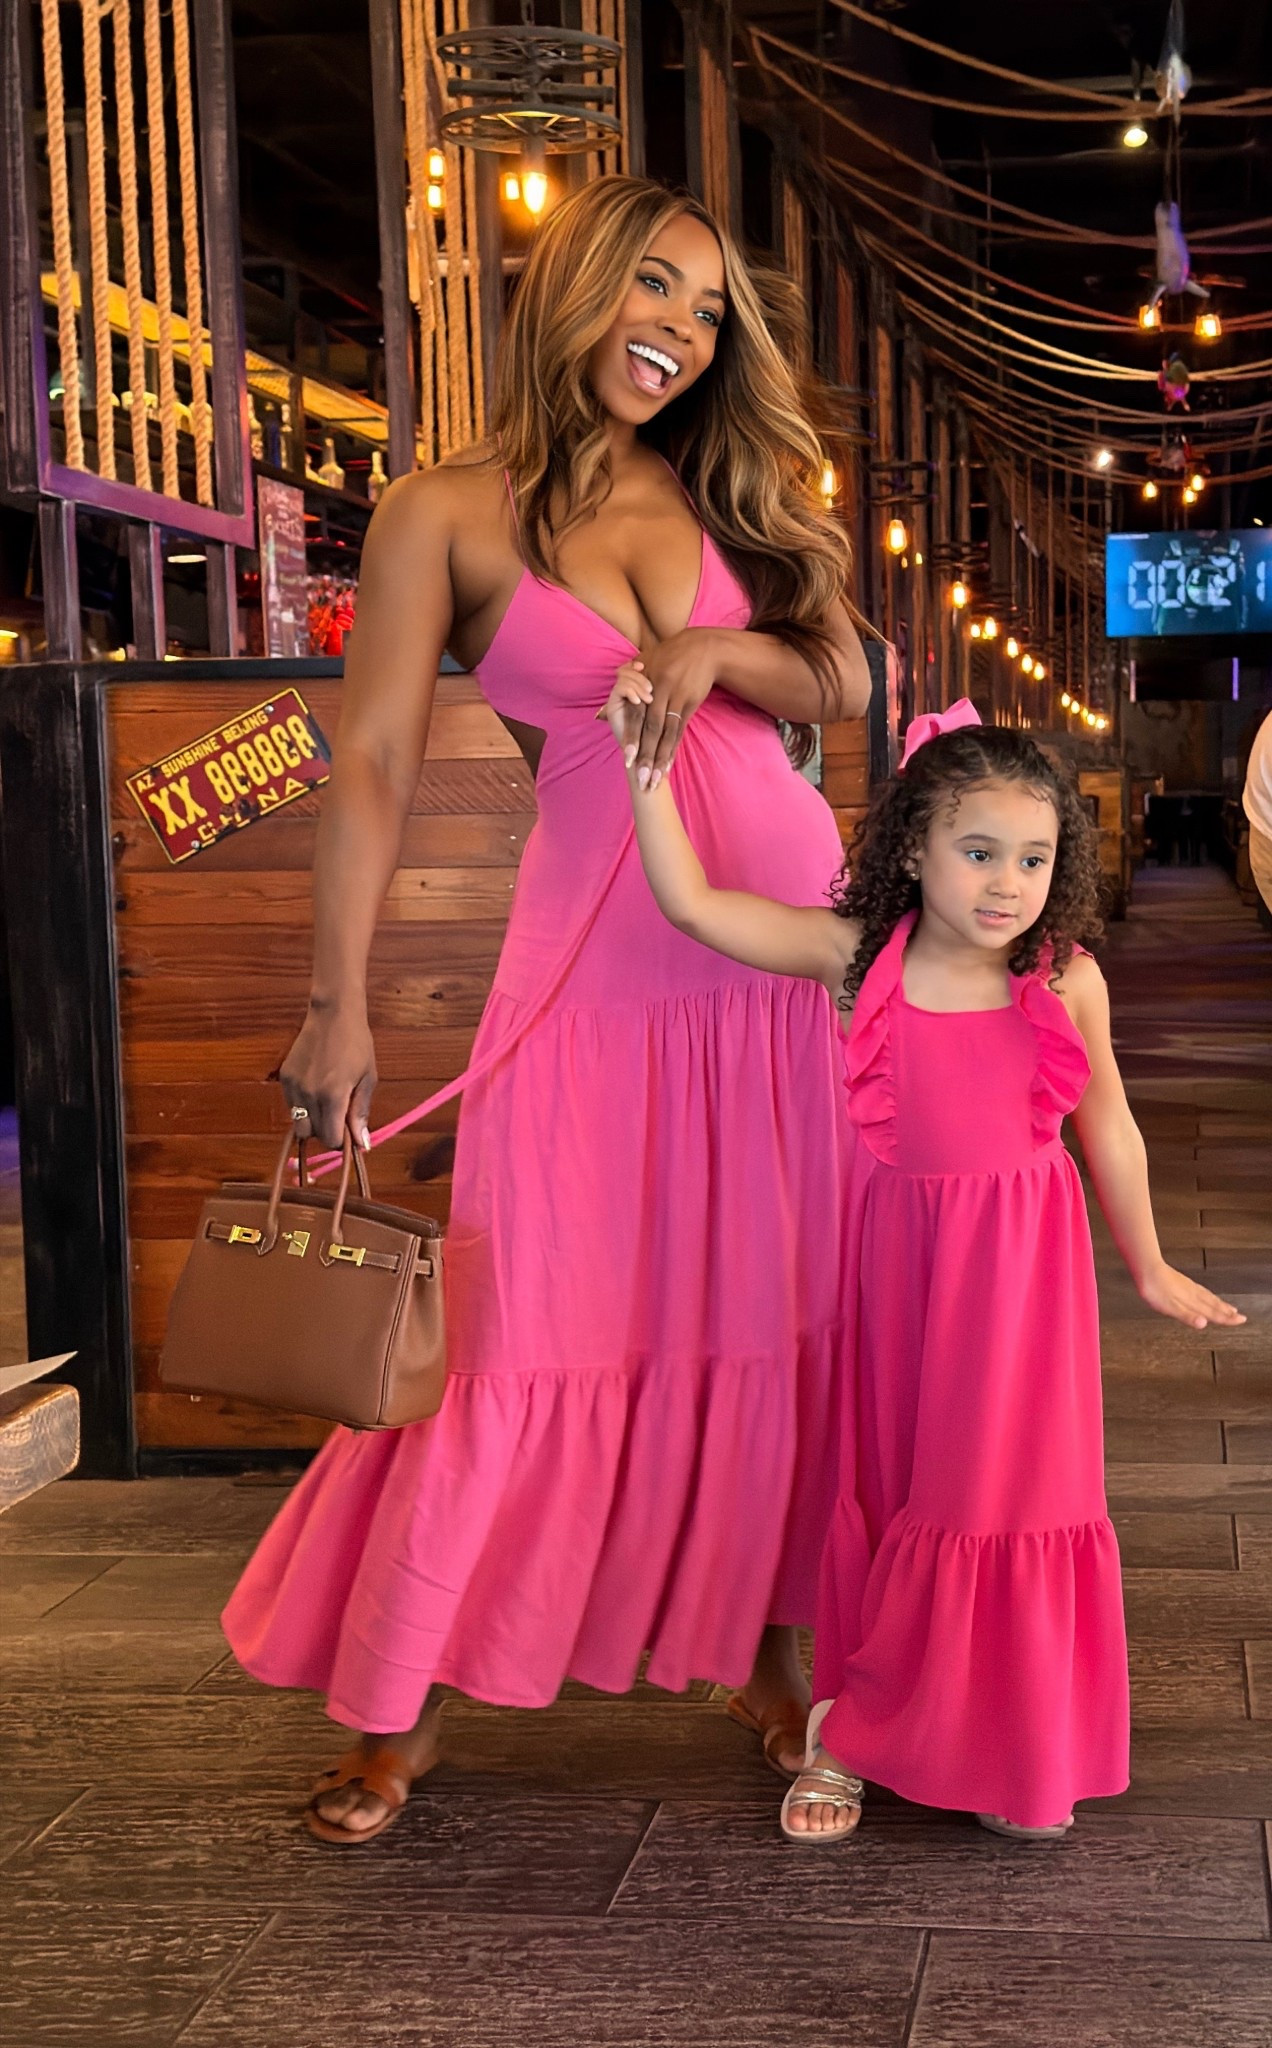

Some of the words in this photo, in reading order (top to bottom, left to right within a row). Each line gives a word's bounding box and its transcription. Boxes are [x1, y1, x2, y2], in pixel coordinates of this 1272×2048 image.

[161, 737, 222, 779] SUNSHINE
[222, 710, 269, 744] BEIJING
[148, 775, 208, 836] XX
